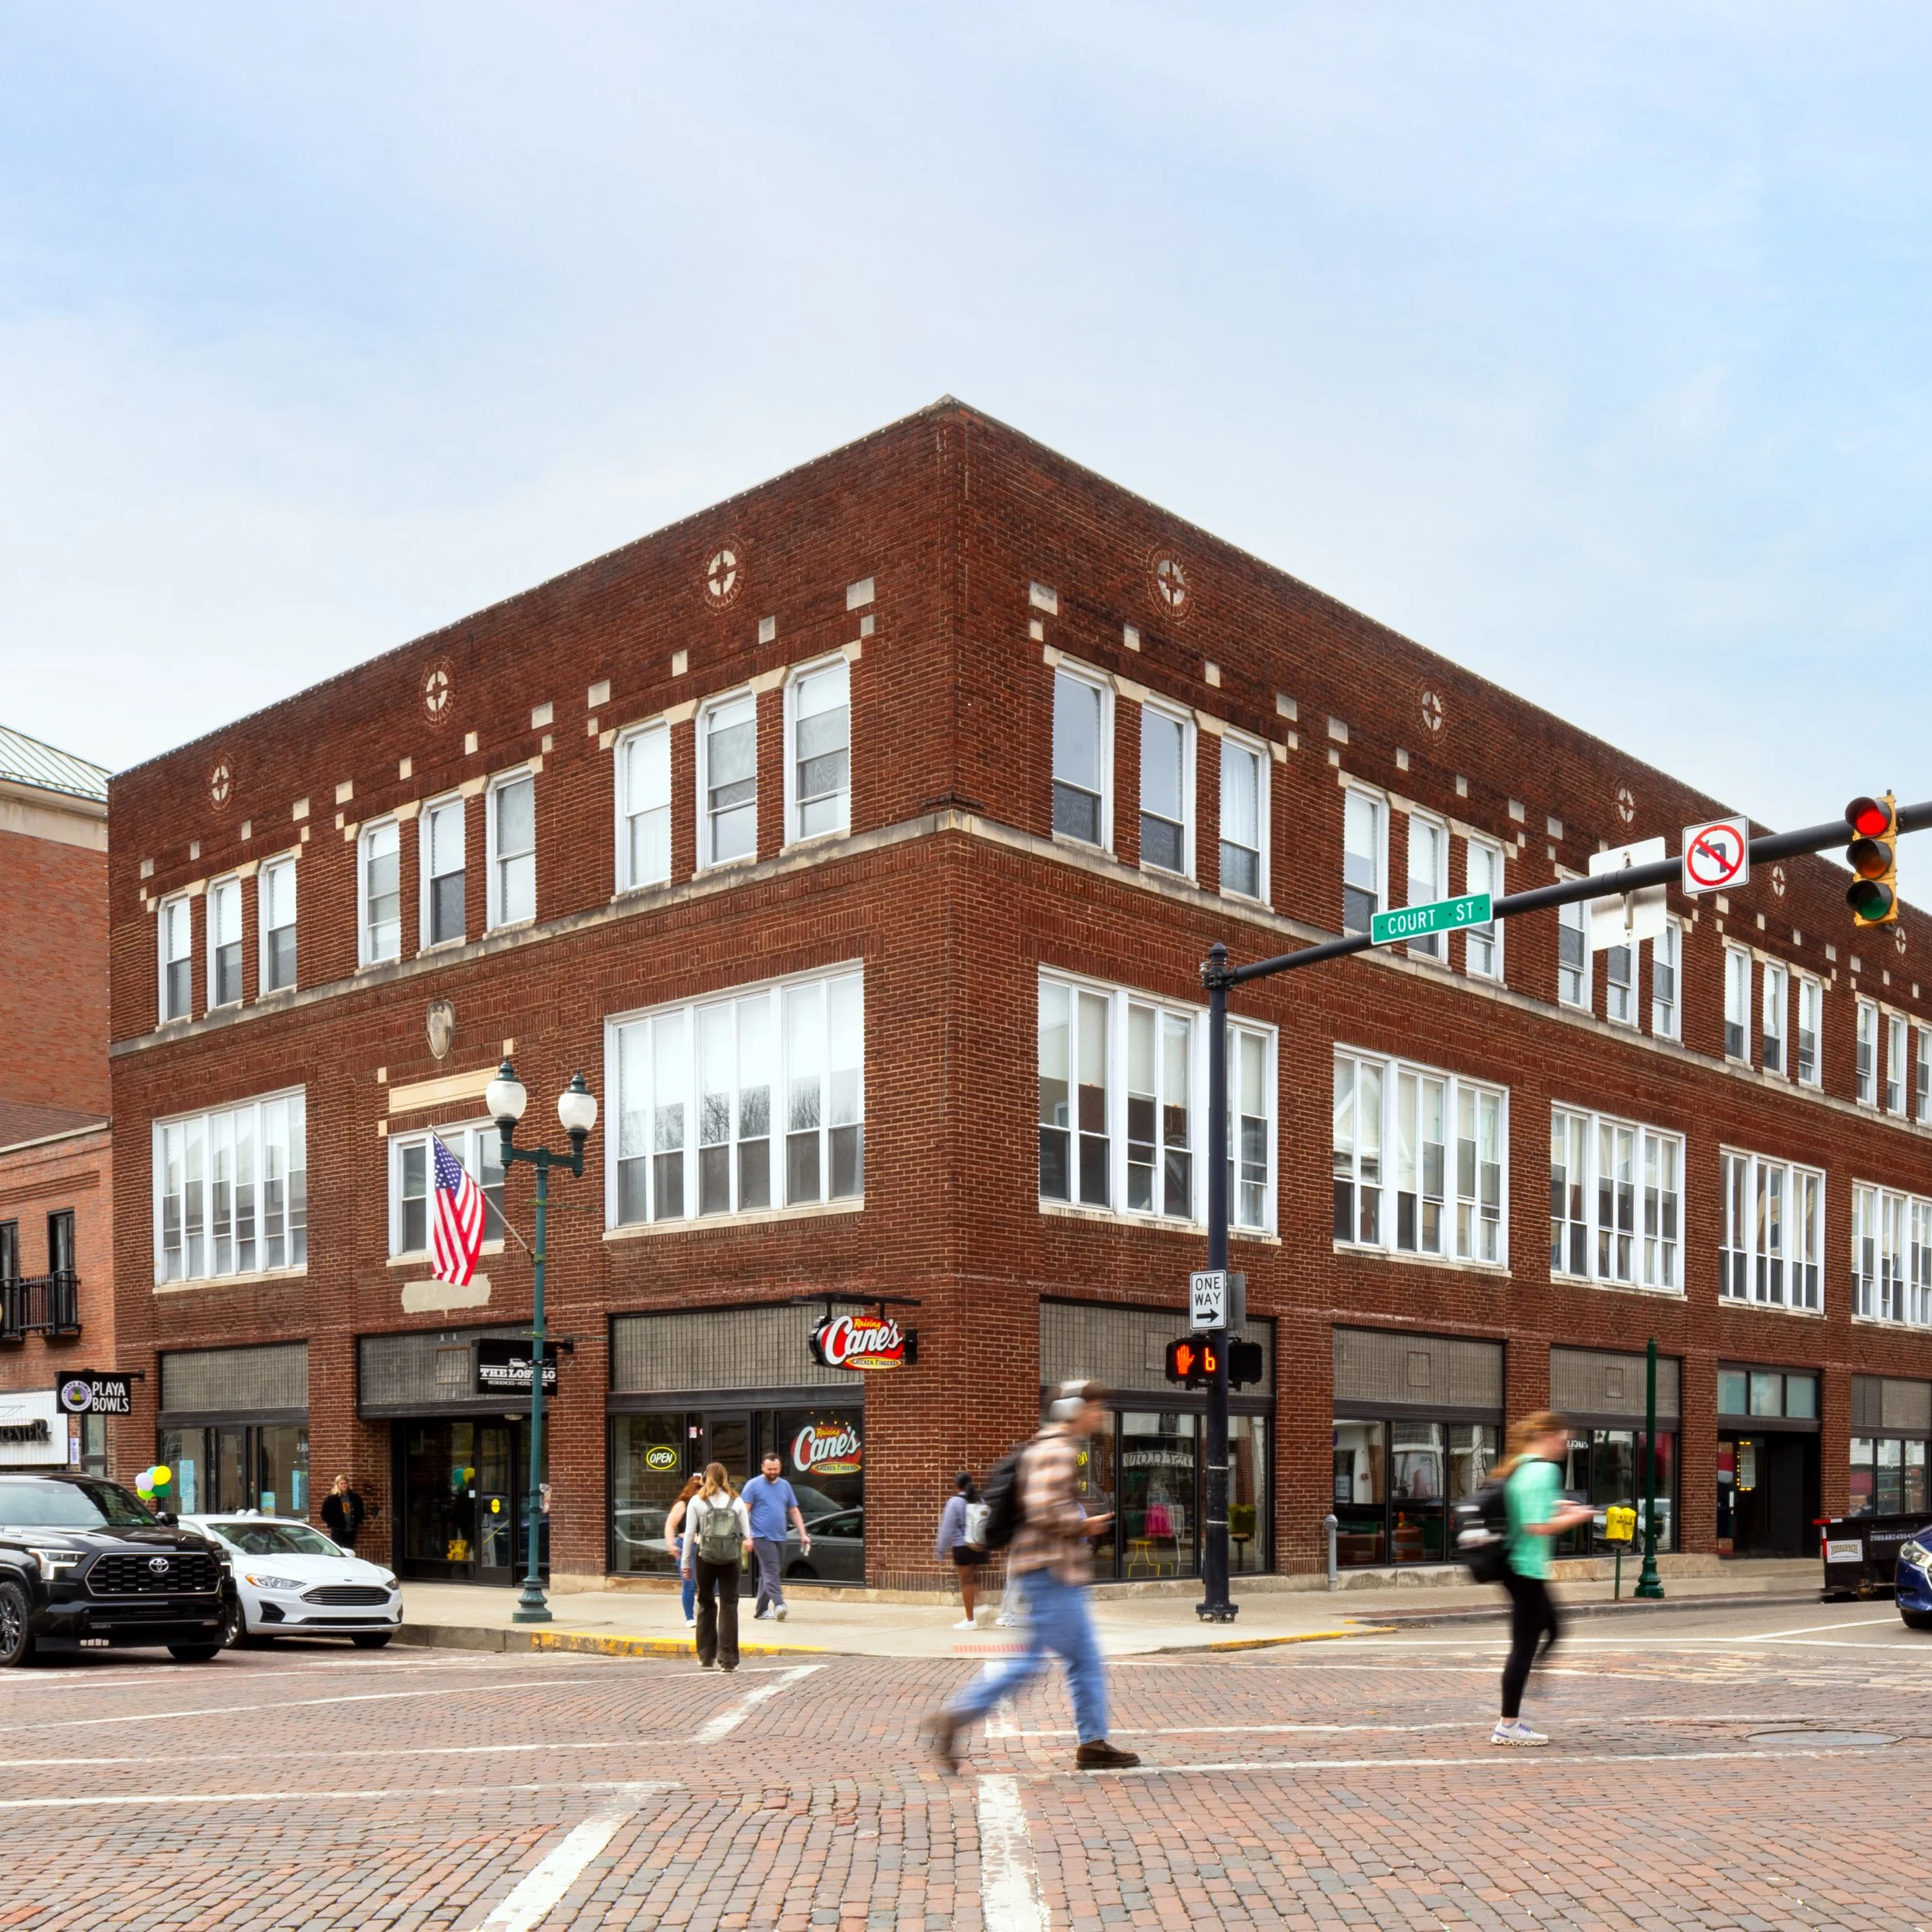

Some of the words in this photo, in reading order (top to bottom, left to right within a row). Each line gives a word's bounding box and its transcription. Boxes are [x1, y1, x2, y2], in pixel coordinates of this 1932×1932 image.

[1388, 910, 1435, 934] COURT
[1456, 902, 1474, 922] ST
[1196, 1277, 1220, 1291] ONE
[1195, 1292, 1221, 1306] WAY
[854, 1318, 881, 1329] Raising
[825, 1315, 903, 1365] Cane's
[1205, 1347, 1216, 1371] 6
[480, 1368, 507, 1377] THE
[509, 1369, 556, 1379] LOSO
[92, 1382, 125, 1396] PLAYA
[92, 1397, 129, 1412] BOWLS
[816, 1428, 841, 1437] Raising
[794, 1426, 861, 1471] Cane's
[649, 1453, 673, 1464] OPEN
